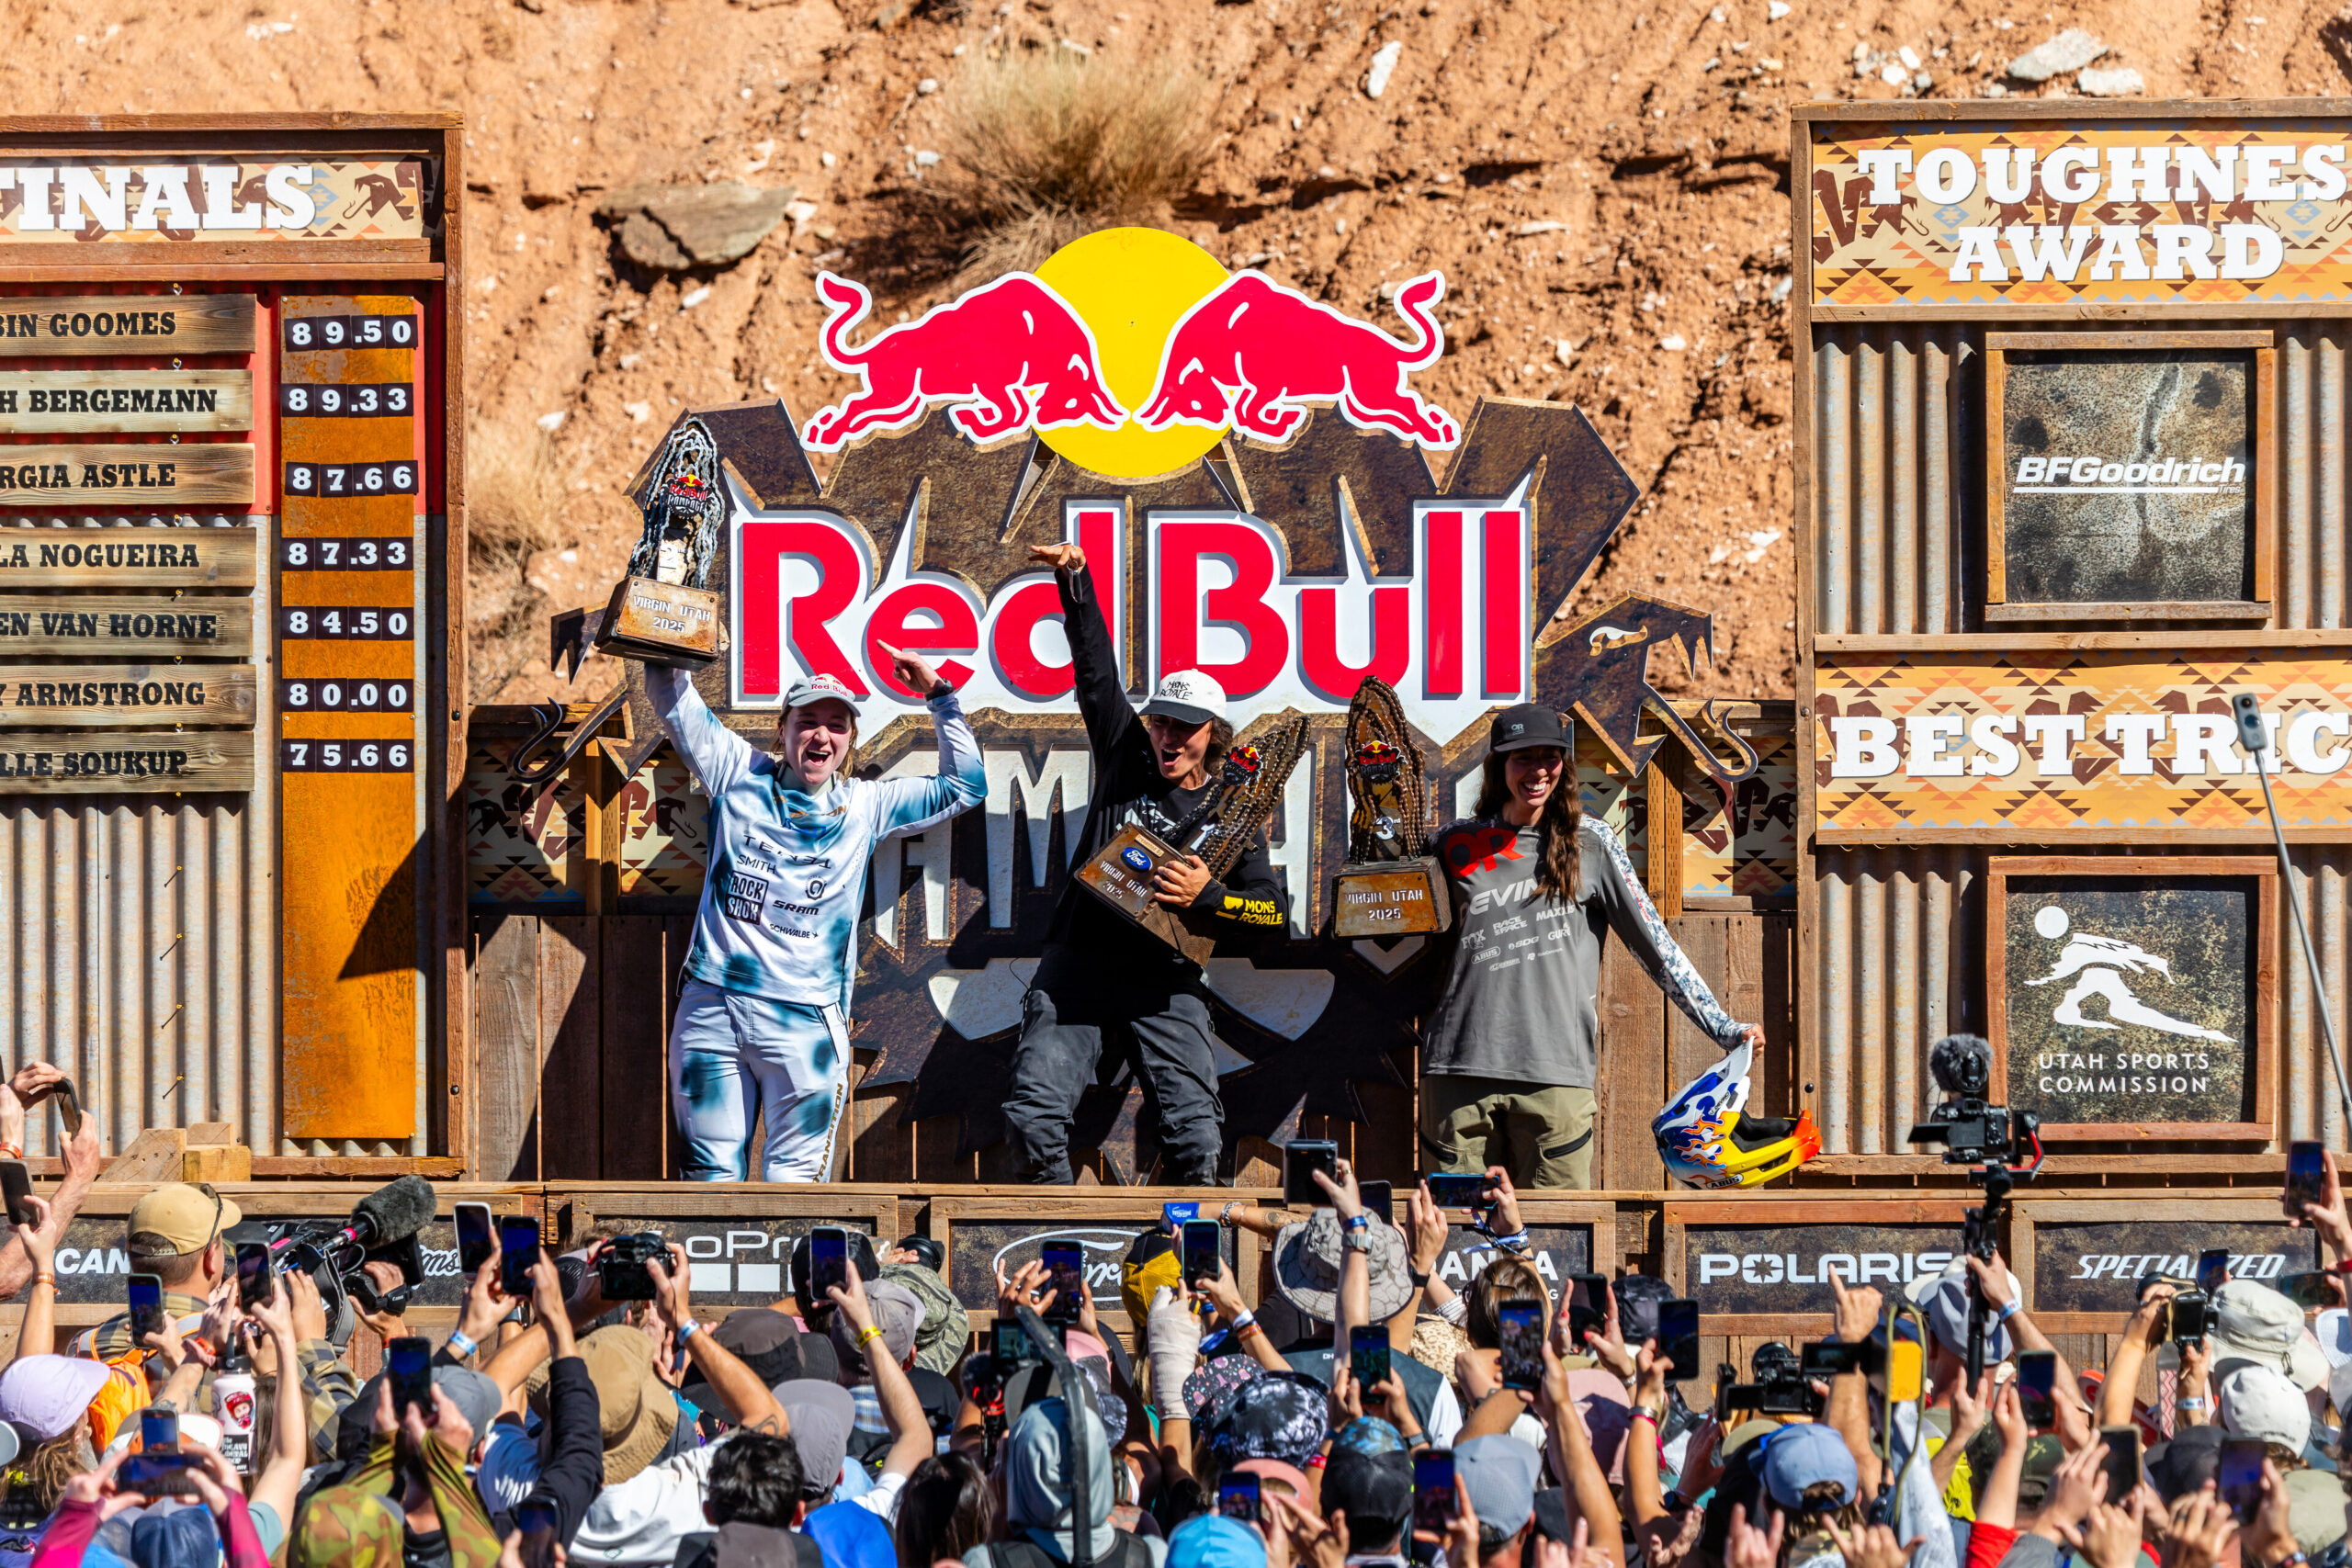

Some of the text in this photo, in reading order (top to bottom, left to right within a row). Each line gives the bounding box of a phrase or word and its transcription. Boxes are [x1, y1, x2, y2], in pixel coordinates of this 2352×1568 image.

[1858, 145, 2347, 205] TOUGHNES
[1949, 224, 2285, 282] AWARD
[0, 312, 175, 337] IN GOOMES
[292, 320, 412, 345] 89.50
[29, 389, 217, 413] BERGEMANN
[288, 388, 406, 412] 89.33
[81, 463, 175, 488] ASTLE
[292, 465, 412, 491] 87.66
[2016, 457, 2246, 483] BFGoodrich
[671, 483, 707, 501] Red Bull
[2218, 484, 2242, 494] Tires
[40, 544, 199, 569] NOGUEIRA
[288, 542, 406, 566] 87.33
[634, 595, 711, 621] VIRGIN UTAH
[742, 511, 1521, 699] Red Bull
[41, 613, 98, 637] VAN
[109, 613, 217, 638] HORNE
[289, 610, 407, 635] 84.50
[652, 616, 685, 633] 2025
[16, 682, 205, 706] ARMSTRONG
[289, 682, 407, 707] 80.00
[832, 685, 848, 697] Bull
[289, 744, 407, 768] 75.66
[1360, 752, 1396, 765] Red Bull
[1831, 715, 2086, 779] BEST
[62, 750, 187, 777] SOUKUP
[737, 854, 777, 874] SMITH
[1126, 850, 1147, 866] Ford
[731, 875, 764, 900] ROCK
[1126, 879, 1148, 897] UTAH
[1345, 889, 1423, 905] VIRGIN UTAH
[728, 897, 759, 921] SHOX
[773, 900, 820, 916] SRAM
[1245, 898, 1276, 914] MONS
[1368, 908, 1401, 921] 2025
[770, 923, 810, 939] SCHWALBE
[1238, 912, 1283, 926] ROYALE
[1493, 916, 1522, 931] RACE
[2040, 1053, 2210, 1070] UTAH SPORTS
[2040, 1077, 2207, 1094] COMMISSION
[1712, 1176, 1739, 1188] ABUS
[646, 1230, 802, 1259] oPr
[53, 1247, 131, 1275] CAN
[1431, 1250, 1559, 1280] ANA
[1700, 1252, 1952, 1284] POLARIS
[2070, 1254, 2287, 1280] SPECIAZED
